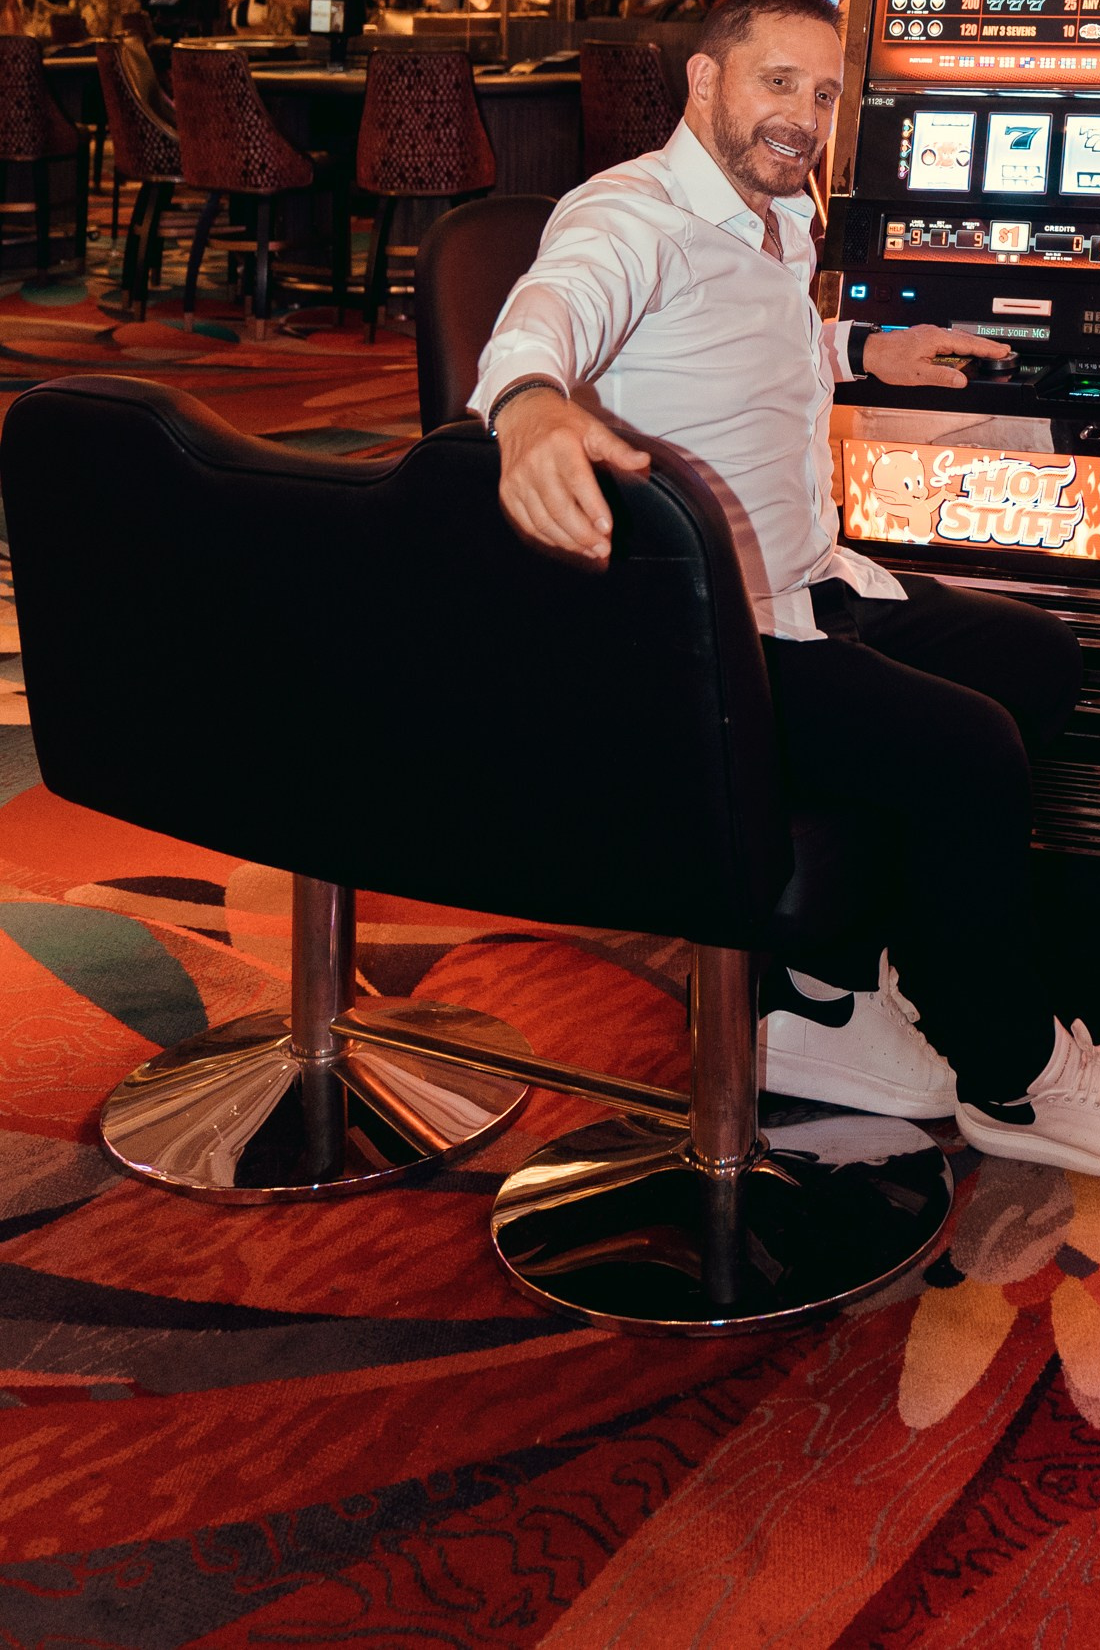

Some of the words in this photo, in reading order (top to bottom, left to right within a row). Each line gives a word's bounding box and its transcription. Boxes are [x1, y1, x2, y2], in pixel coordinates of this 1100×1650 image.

[1082, 0, 1098, 10] ANY
[960, 23, 978, 36] 120
[982, 26, 998, 36] ANY
[999, 26, 1006, 36] 3
[1006, 26, 1036, 37] SEVENS
[1063, 24, 1075, 38] 10
[912, 230, 920, 244] 9
[942, 232, 946, 246] 1
[974, 232, 982, 246] 9
[998, 226, 1020, 248] $1
[1072, 236, 1081, 252] 0
[977, 324, 1004, 336] Insert
[1008, 328, 1028, 338] your
[963, 457, 1077, 507] HOT
[937, 493, 1085, 549] STUFF
